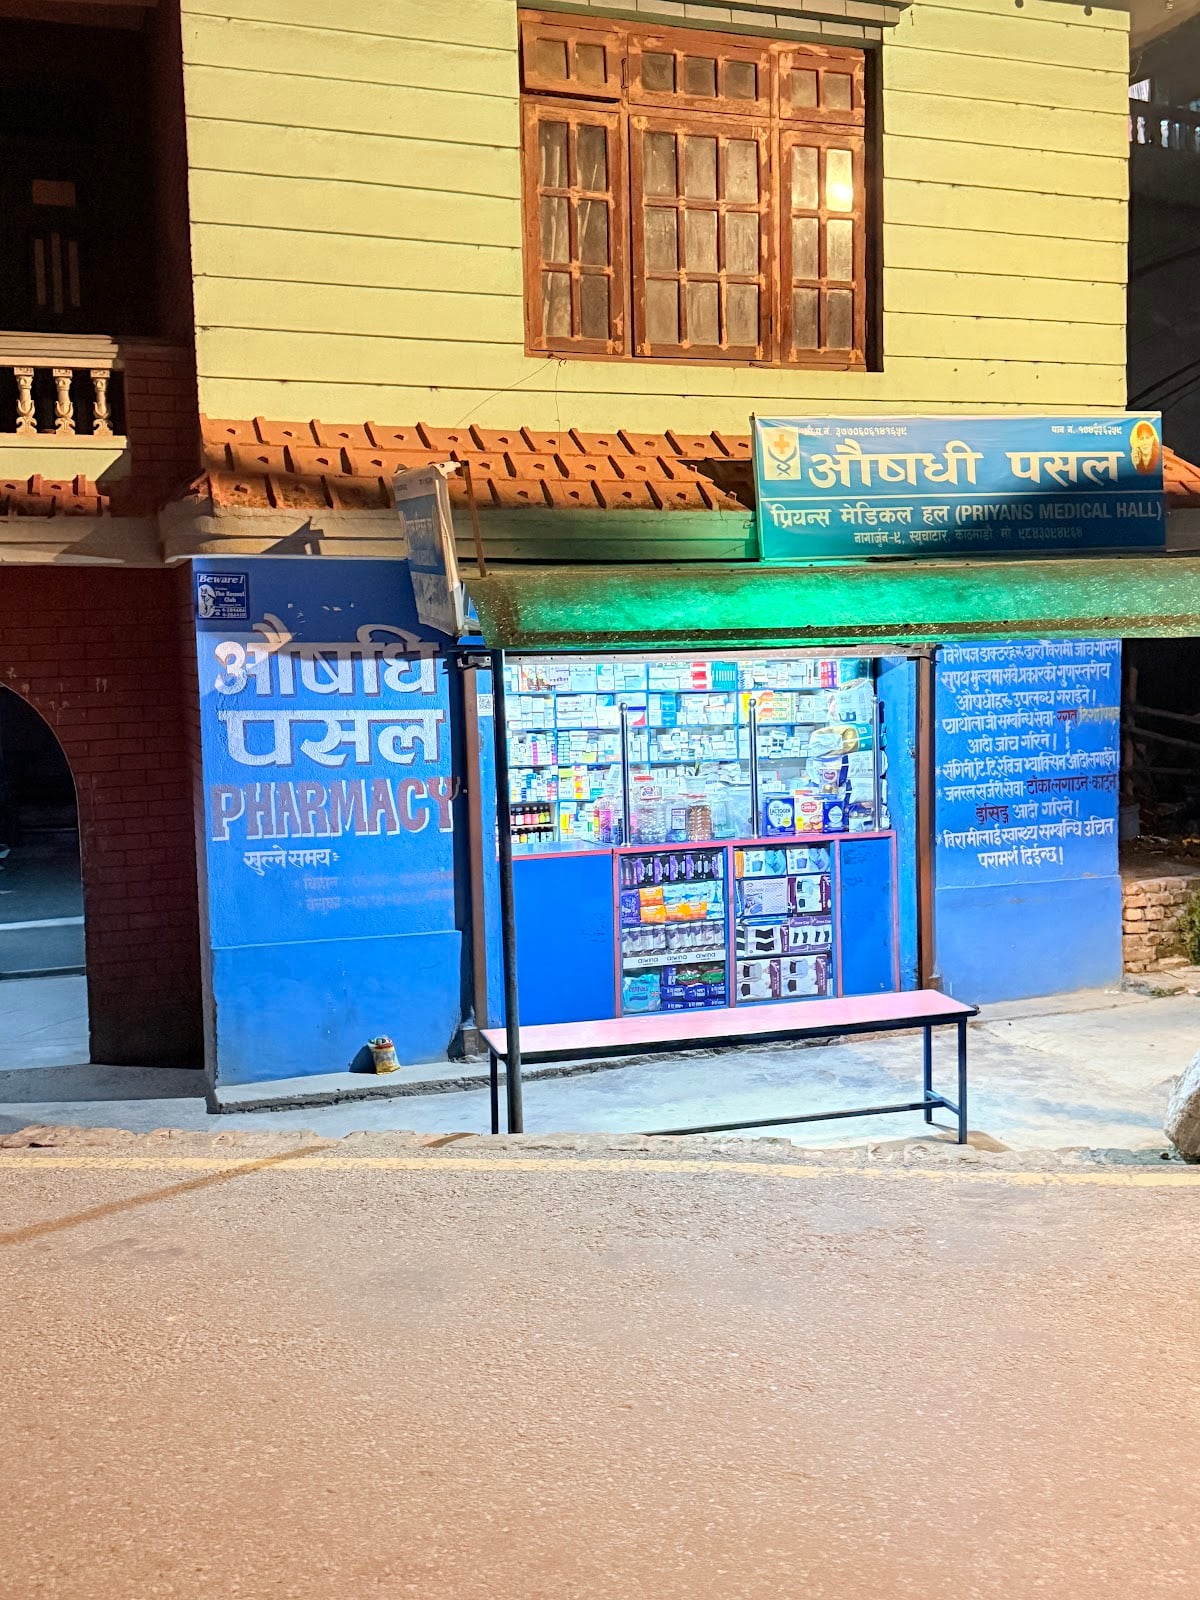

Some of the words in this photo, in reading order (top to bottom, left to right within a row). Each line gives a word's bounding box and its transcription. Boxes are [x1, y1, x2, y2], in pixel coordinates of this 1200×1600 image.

[808, 438, 984, 488] औषधी
[1005, 451, 1126, 487] पसल
[770, 503, 832, 528] प्रियन्स
[840, 501, 913, 526] मेडिकल
[921, 505, 951, 526] हल
[955, 503, 1034, 525] (PRIYANS
[1039, 502, 1112, 519] MEDICAL
[1116, 501, 1162, 521] HALL)
[200, 575, 244, 584] Beware!
[214, 612, 440, 697] औषधि
[941, 670, 969, 692] सुपथ
[1017, 662, 1056, 685] प्रकारको
[1057, 660, 1111, 686] गुणस्तरीय
[218, 709, 446, 768] पसल
[943, 783, 976, 804] जनरल
[211, 776, 460, 841] PHARMACY
[1084, 815, 1115, 837] उचित
[977, 844, 1018, 870] परामर्श
